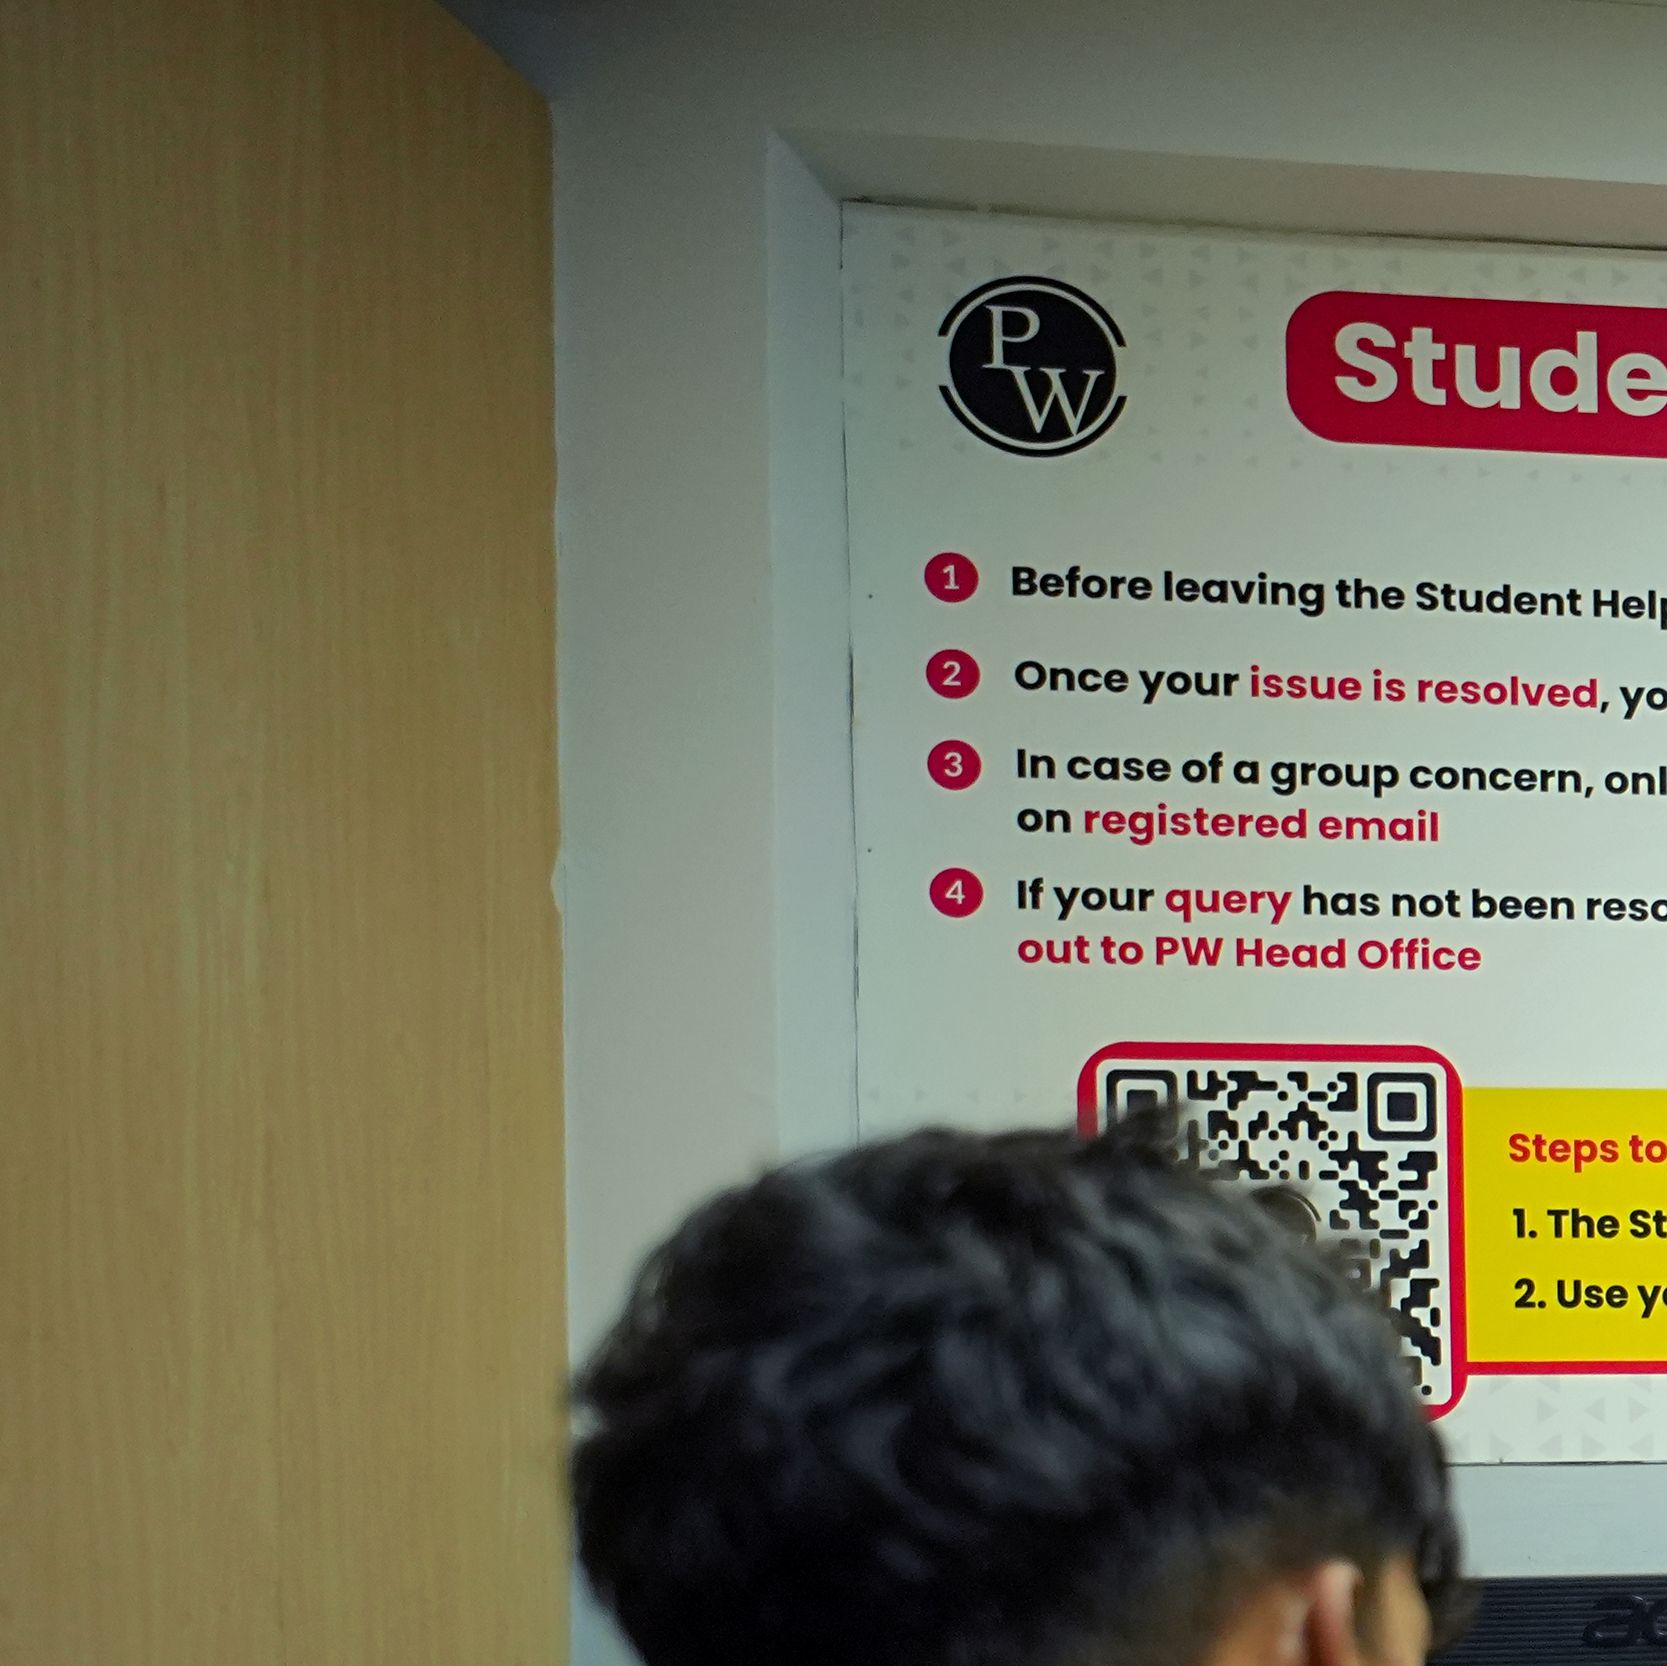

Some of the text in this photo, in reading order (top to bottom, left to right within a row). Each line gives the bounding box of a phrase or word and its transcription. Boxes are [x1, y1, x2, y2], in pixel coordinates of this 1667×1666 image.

[943, 565, 960, 590] 1
[1012, 565, 1153, 600] Before
[1164, 571, 1325, 617] leaving
[1335, 578, 1406, 610] the
[1416, 582, 1582, 616] Student
[942, 661, 961, 686] 2
[1015, 661, 1129, 693] Once
[1138, 670, 1239, 704] your
[1251, 665, 1362, 701] issue
[1373, 669, 1406, 702] is
[1418, 676, 1609, 713] resolved,
[944, 751, 963, 777] 3
[1017, 749, 1056, 779] In
[1067, 756, 1171, 782] case
[1182, 751, 1223, 784] of
[1233, 760, 1259, 784] a
[1270, 762, 1399, 798] group
[1409, 766, 1594, 798] concern,
[1017, 802, 1438, 846] on registered email
[945, 880, 965, 905] 4
[1018, 877, 1044, 910] If
[1053, 887, 1155, 921] your
[1165, 889, 1292, 925] query
[1303, 885, 1380, 916] has
[1392, 890, 1461, 918] not
[1472, 888, 1574, 920] been
[1018, 935, 1481, 971] out to PW Head Office
[1509, 1133, 1619, 1173] Steps
[1629, 1135, 1667, 1163] to
[1513, 1208, 1538, 1239] 1.
[1547, 1208, 1620, 1239] The
[1514, 1278, 1546, 1309] 2.
[1557, 1279, 1629, 1308] Use
